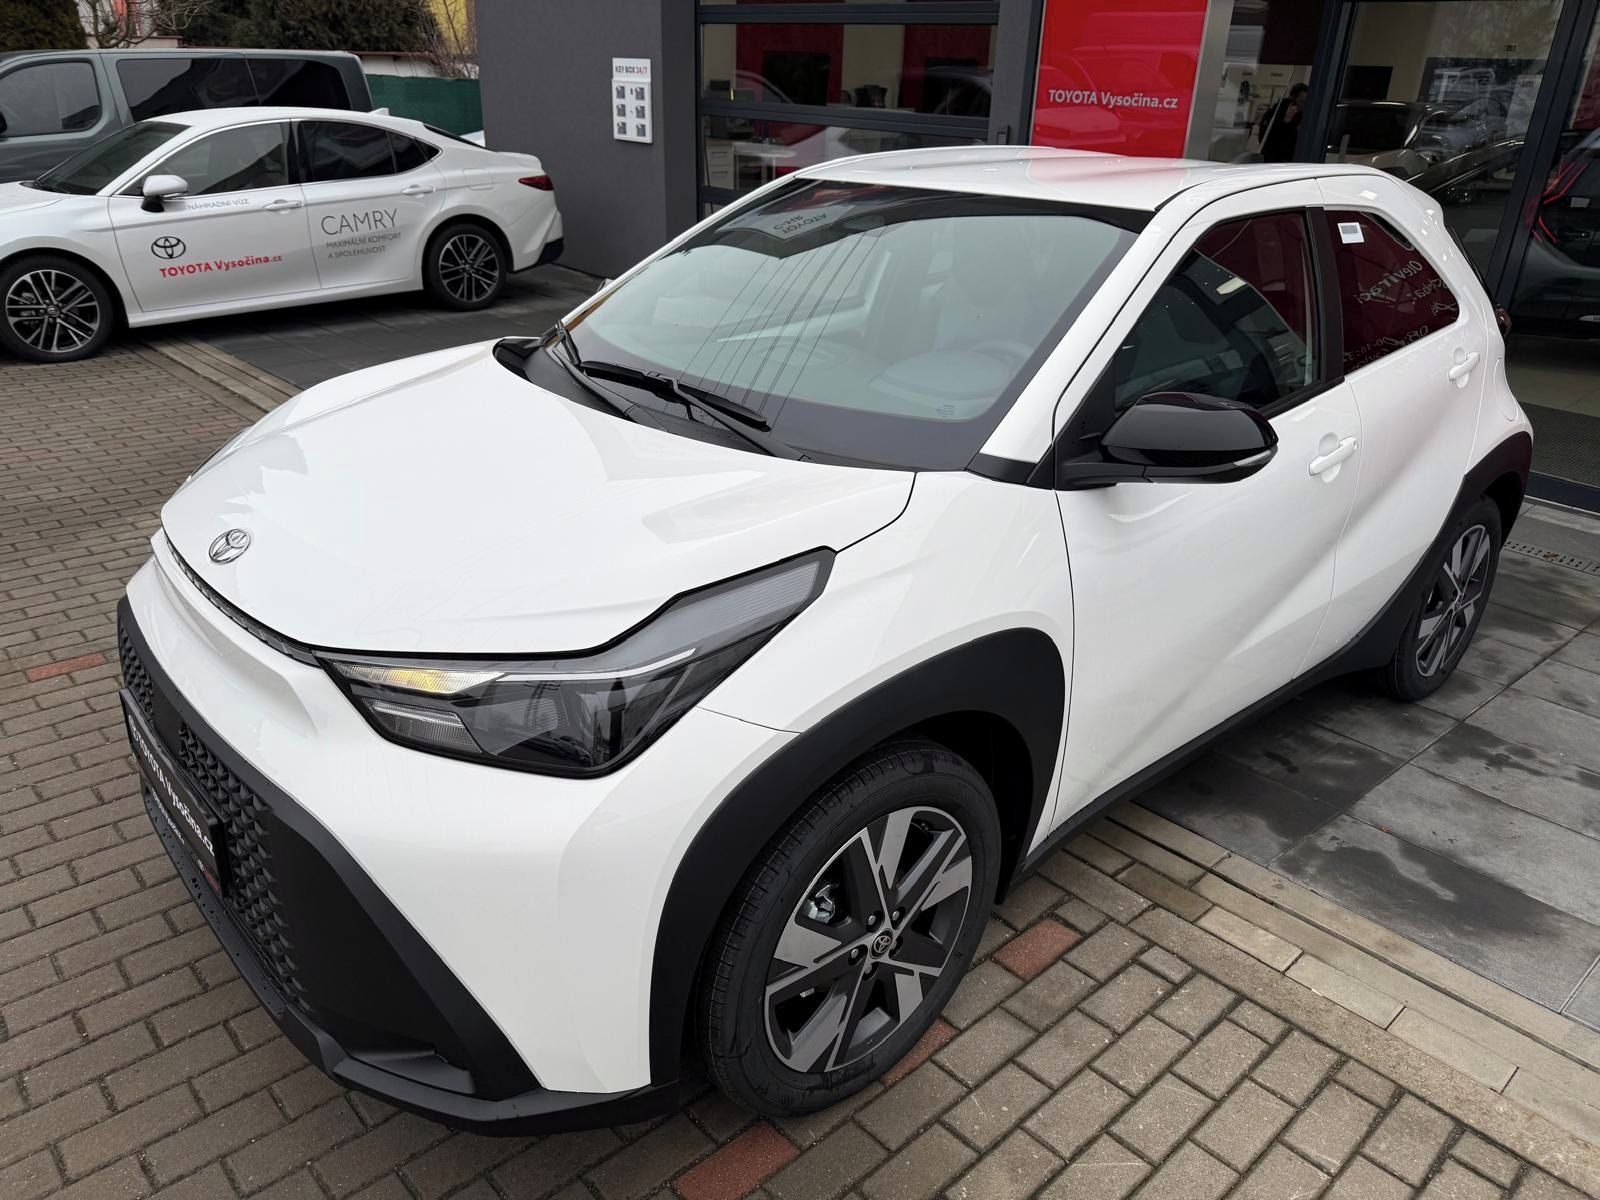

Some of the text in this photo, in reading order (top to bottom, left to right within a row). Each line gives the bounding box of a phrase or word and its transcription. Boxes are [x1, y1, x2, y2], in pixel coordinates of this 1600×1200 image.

[615, 65, 624, 73] KEY
[624, 65, 635, 74] BOX
[1048, 89, 1179, 109] TOYOTA Vysočina.cz
[320, 208, 397, 236] CAMRY
[368, 232, 402, 244] KOMFORT
[160, 255, 283, 278] TOYOTA Vysočina.cz
[137, 732, 166, 789] TOYOTA
